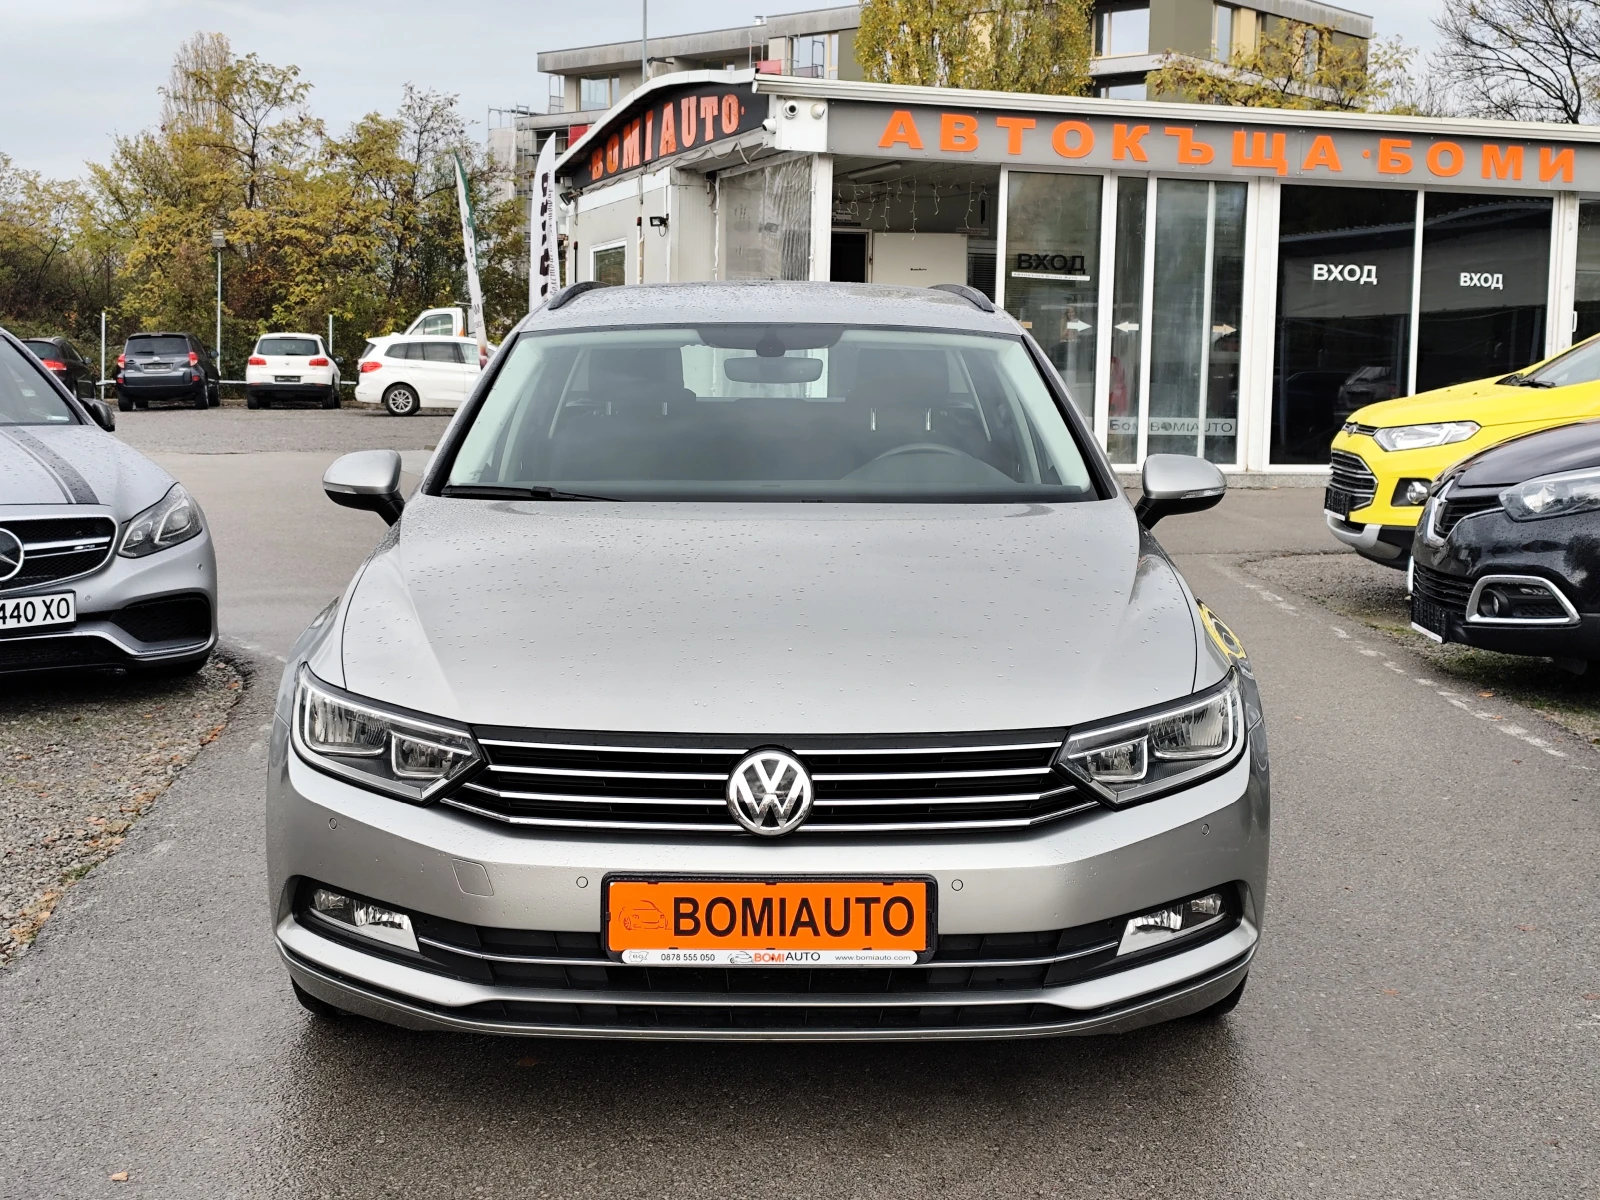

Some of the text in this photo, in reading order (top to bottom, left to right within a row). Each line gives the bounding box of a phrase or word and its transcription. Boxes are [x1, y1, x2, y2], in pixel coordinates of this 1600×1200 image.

[878, 109, 1575, 183] АВТОКЪЩА БОМИ
[1017, 253, 1086, 275] ВХОД
[1313, 263, 1378, 285] ВХОД
[1459, 272, 1504, 290] ВХОД
[673, 896, 915, 938] BOMIAUTO
[661, 953, 681, 962] 0878
[683, 953, 698, 962] 555
[699, 953, 716, 962] 050
[834, 953, 911, 962] www.bomiauto.com
